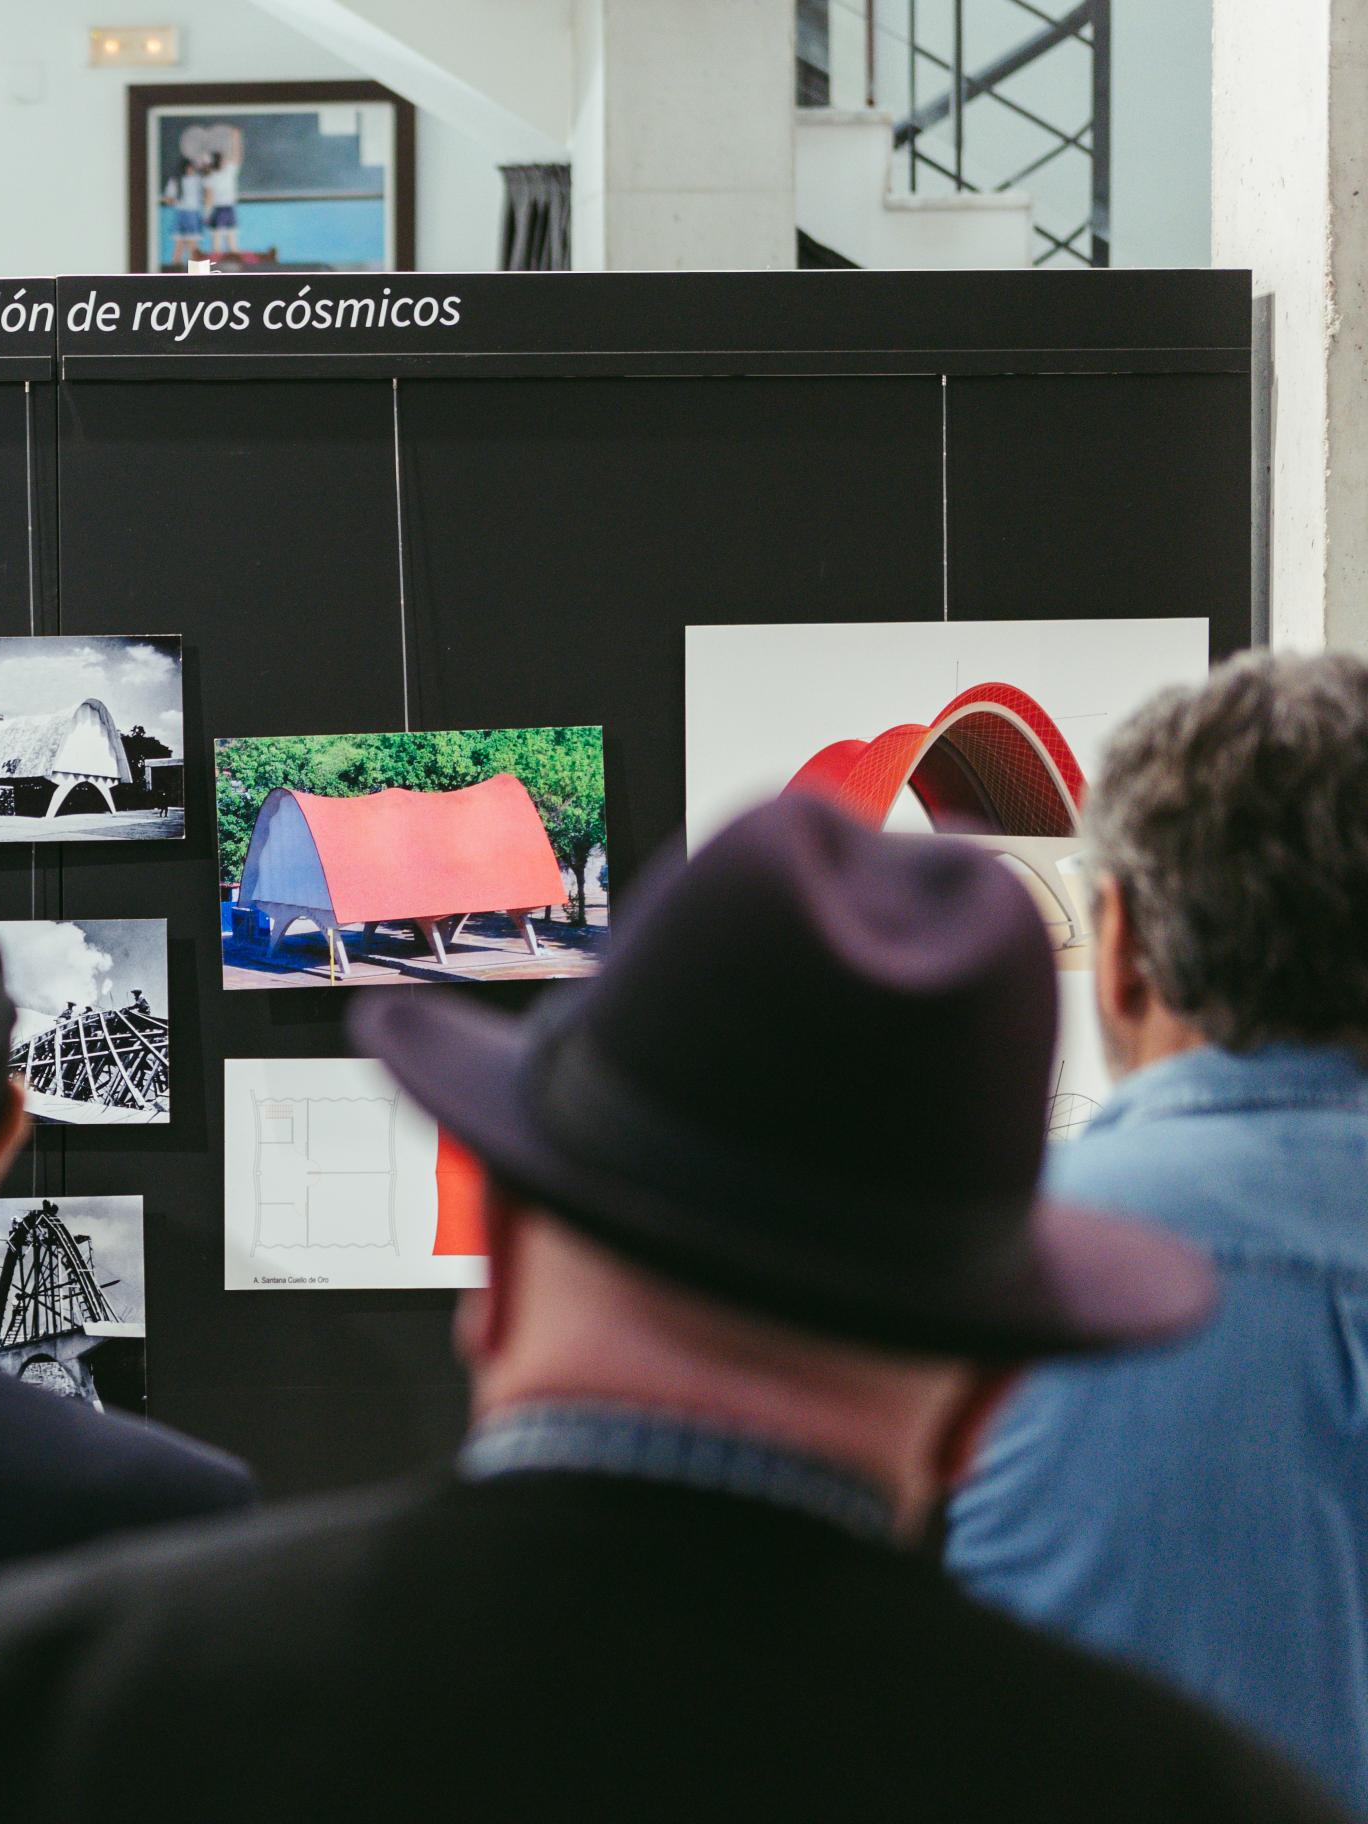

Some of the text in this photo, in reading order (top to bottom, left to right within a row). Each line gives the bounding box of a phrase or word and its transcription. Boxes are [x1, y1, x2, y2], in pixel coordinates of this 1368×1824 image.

[67, 290, 121, 332] de
[132, 300, 251, 342] rayos
[262, 284, 461, 330] cósmicos
